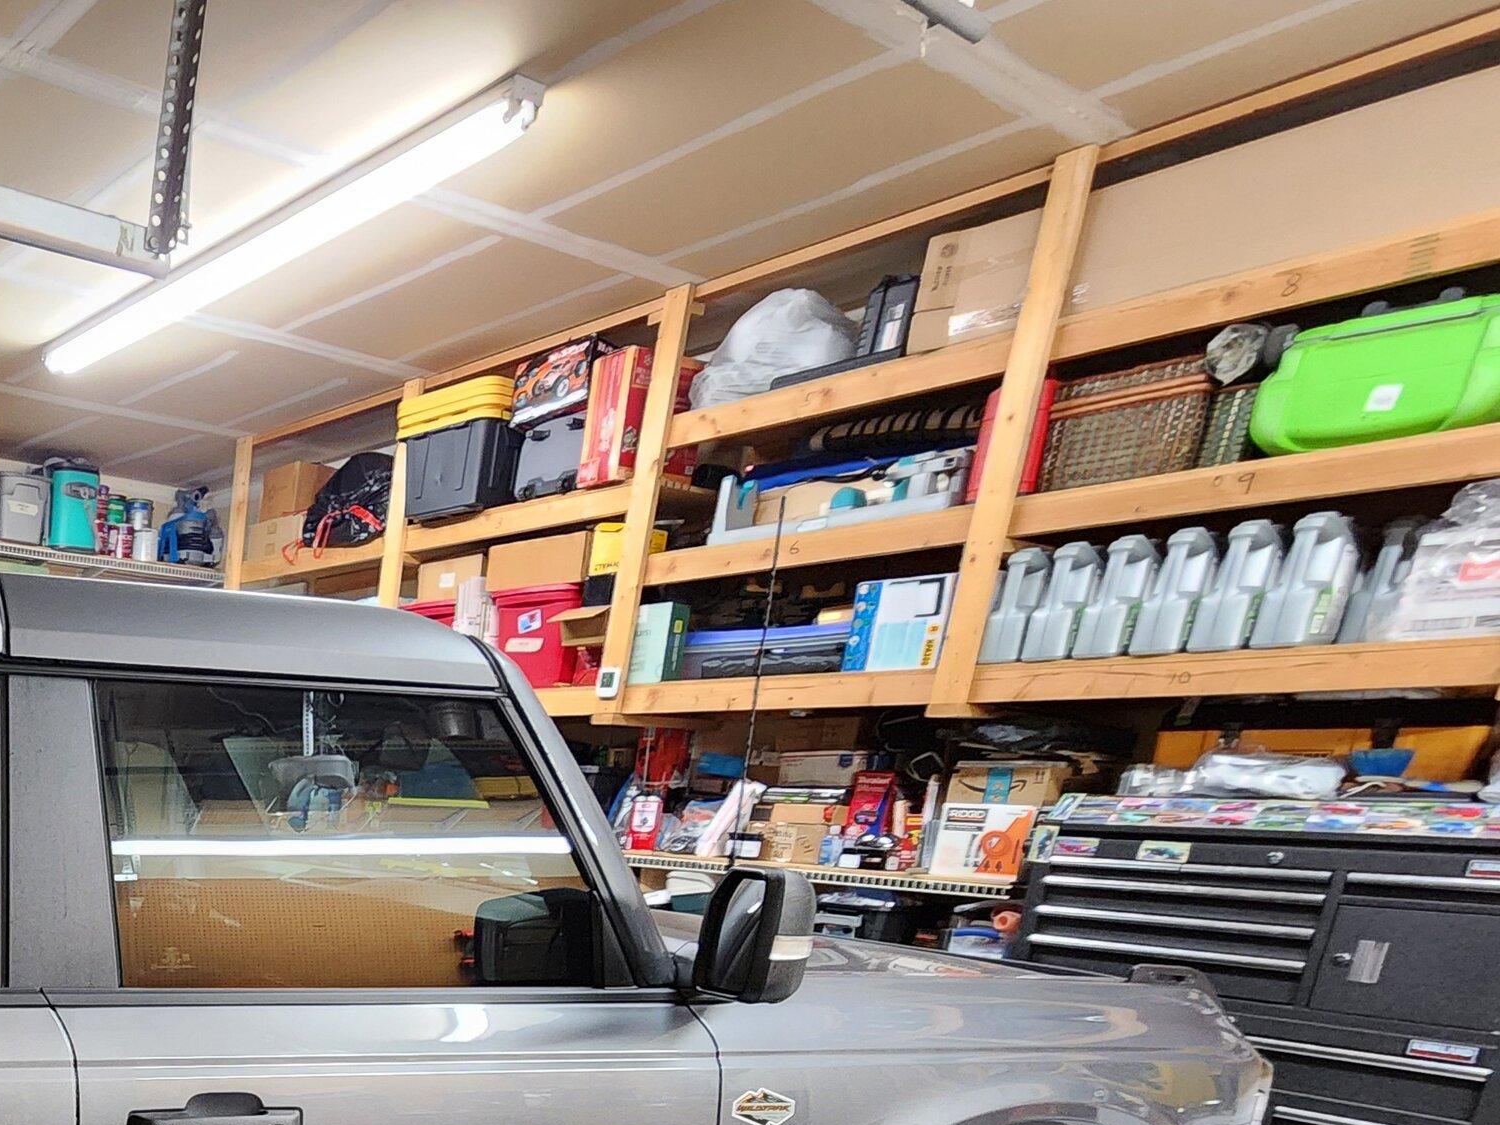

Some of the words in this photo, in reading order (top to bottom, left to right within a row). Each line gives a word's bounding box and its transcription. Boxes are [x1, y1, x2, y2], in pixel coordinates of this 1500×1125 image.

[1280, 272, 1301, 297] 8
[1238, 472, 1255, 494] 9
[789, 540, 800, 555] 6
[736, 1104, 791, 1112] WILDTRAK
